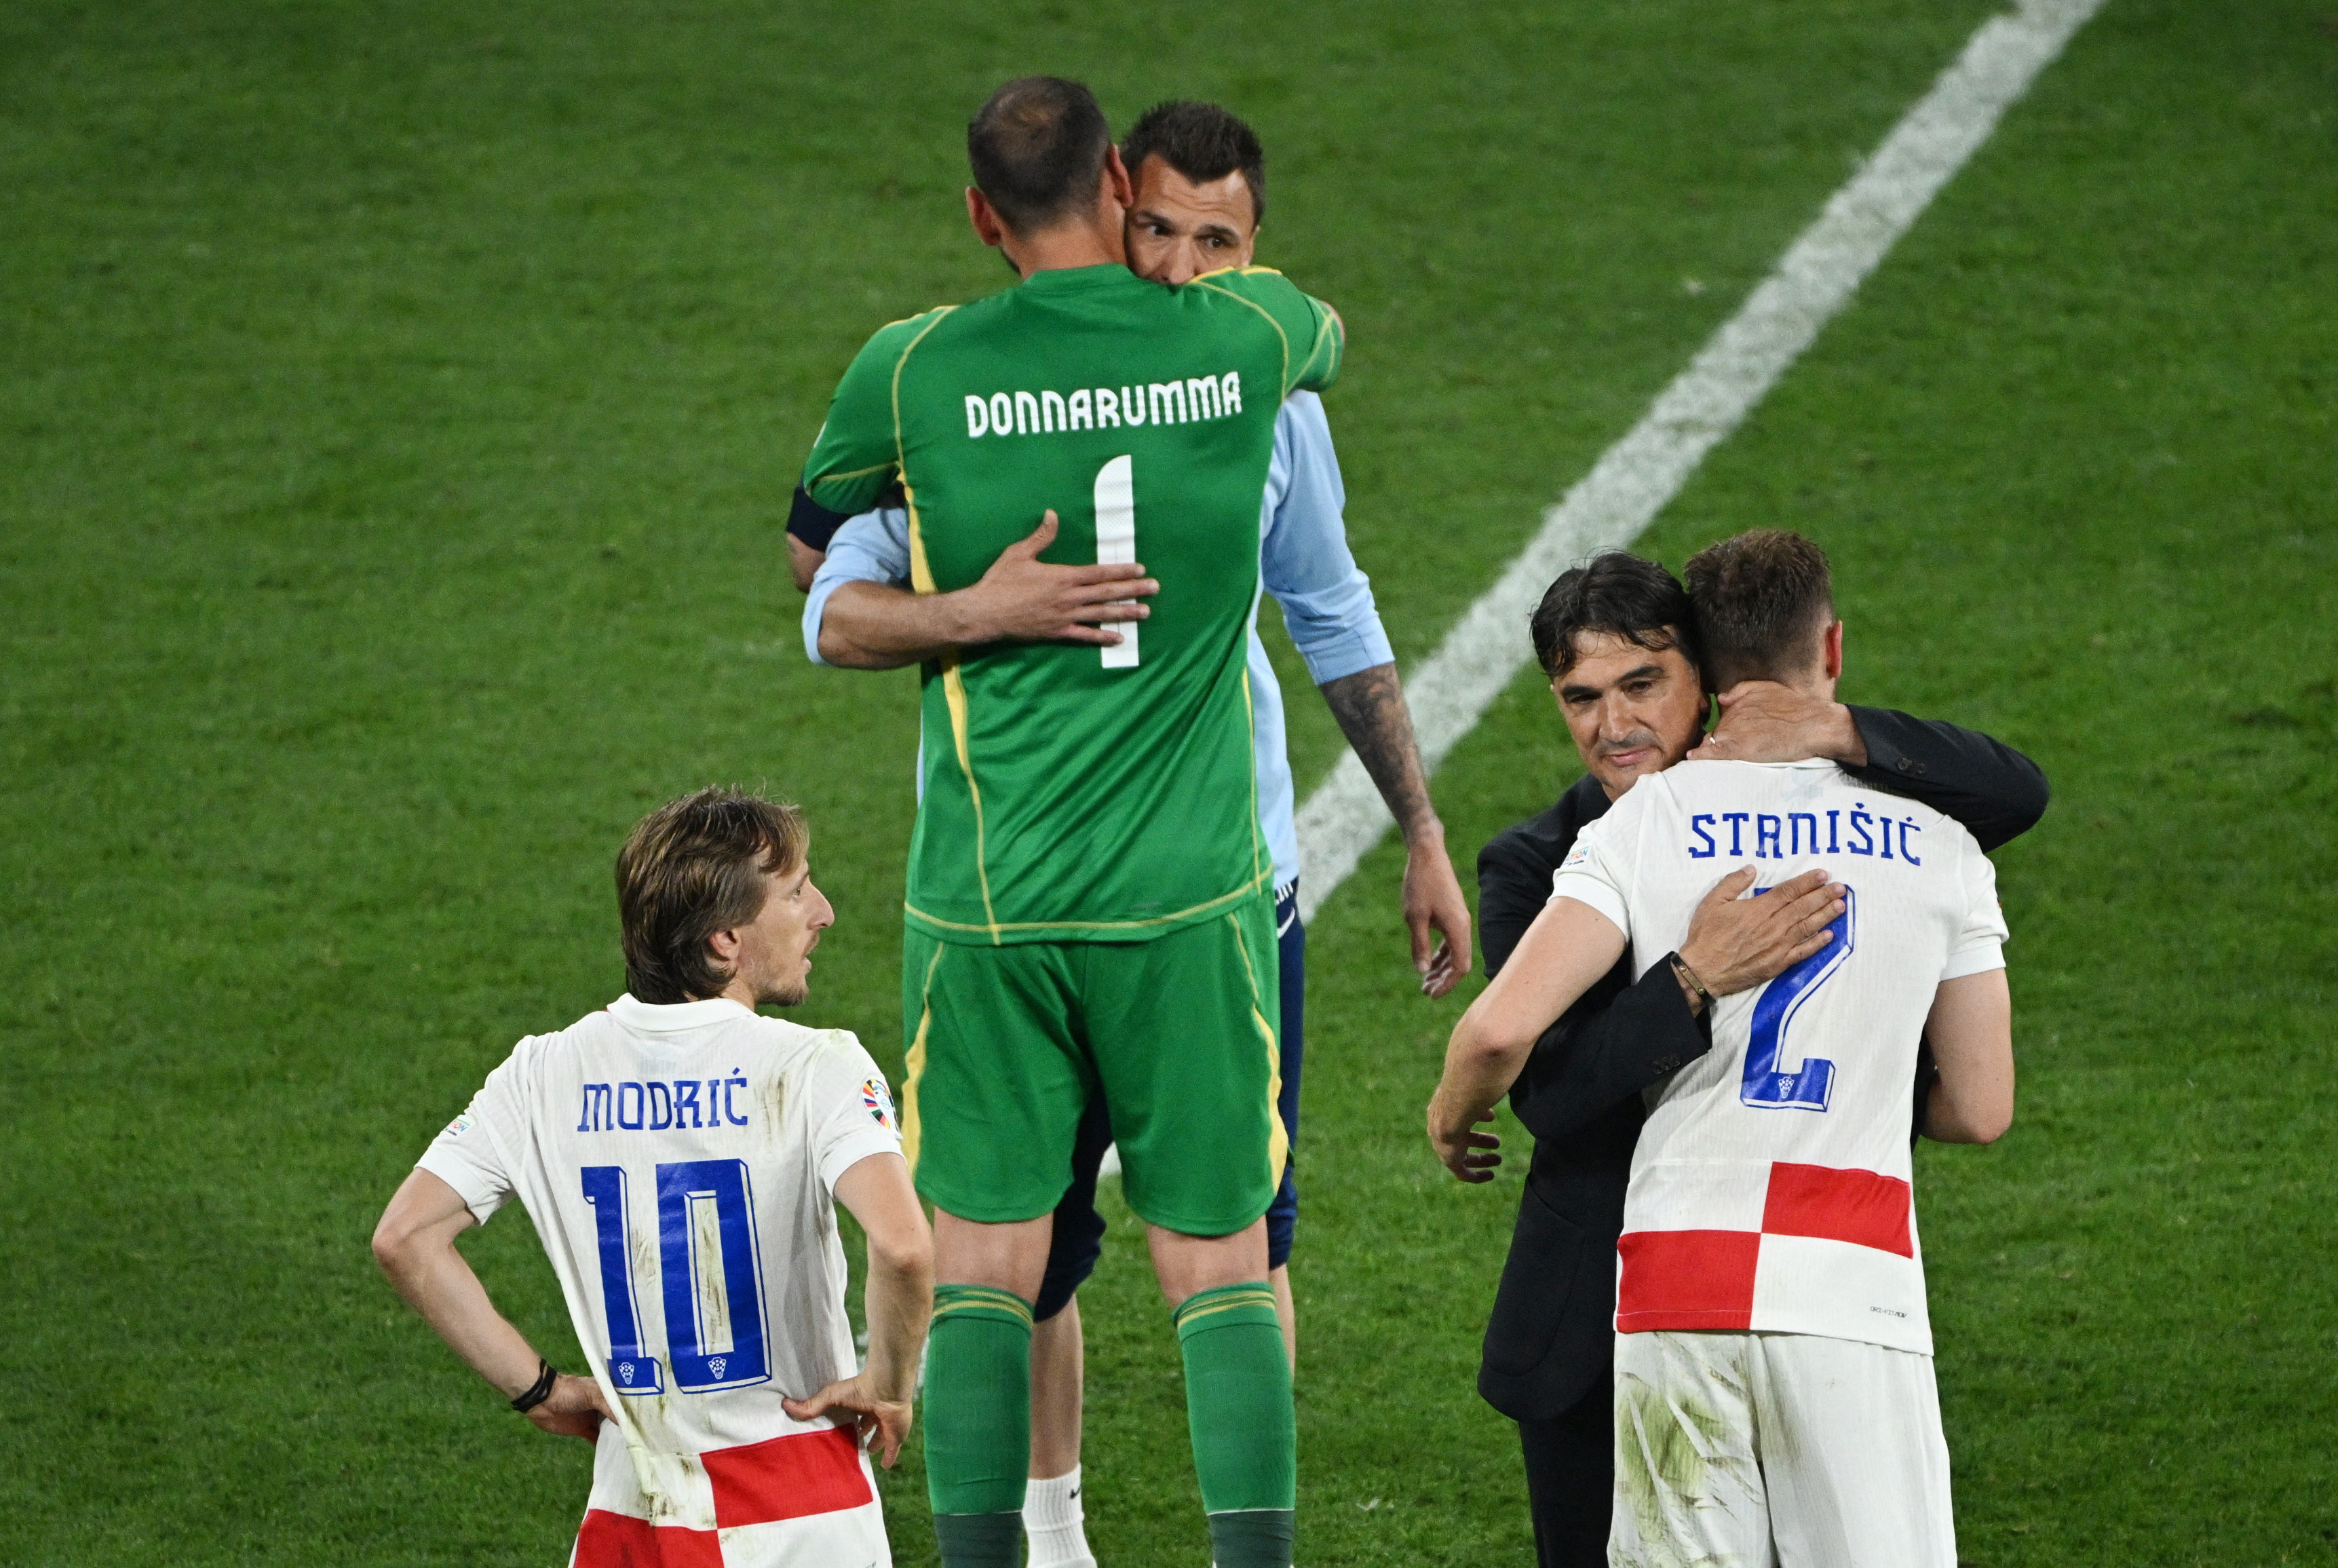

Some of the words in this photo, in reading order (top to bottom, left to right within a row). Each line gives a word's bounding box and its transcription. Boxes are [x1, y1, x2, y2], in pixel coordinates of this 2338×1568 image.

[965, 371, 1242, 438] DONNARUMMA
[1094, 454, 1139, 668] 1
[1688, 802, 1921, 866] STANIŠIĆ
[1740, 884, 1856, 1113] 2
[577, 1067, 748, 1132] MODRIĆ
[581, 1158, 772, 1395] 10
